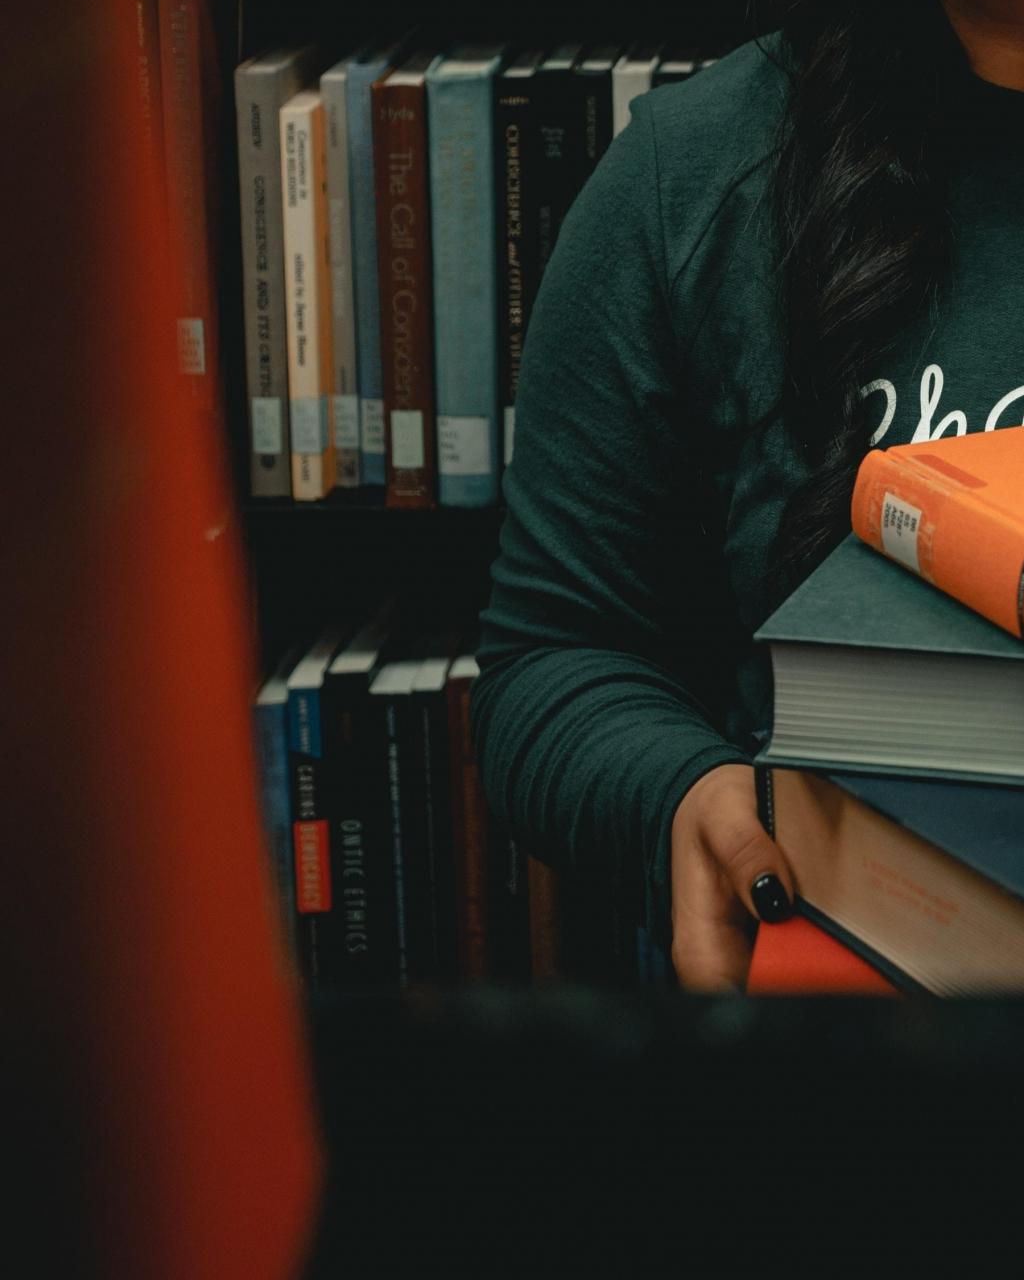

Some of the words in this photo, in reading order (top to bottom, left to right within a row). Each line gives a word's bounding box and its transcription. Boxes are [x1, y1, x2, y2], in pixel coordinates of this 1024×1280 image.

[388, 147, 412, 194] The
[254, 175, 268, 272] CONSCIENCE
[390, 203, 414, 250] Call
[256, 278, 269, 311] AND
[392, 257, 416, 285] of
[392, 289, 418, 409] Conscienc
[340, 819, 364, 877] ONTIC
[343, 888, 368, 954] ETHICS
